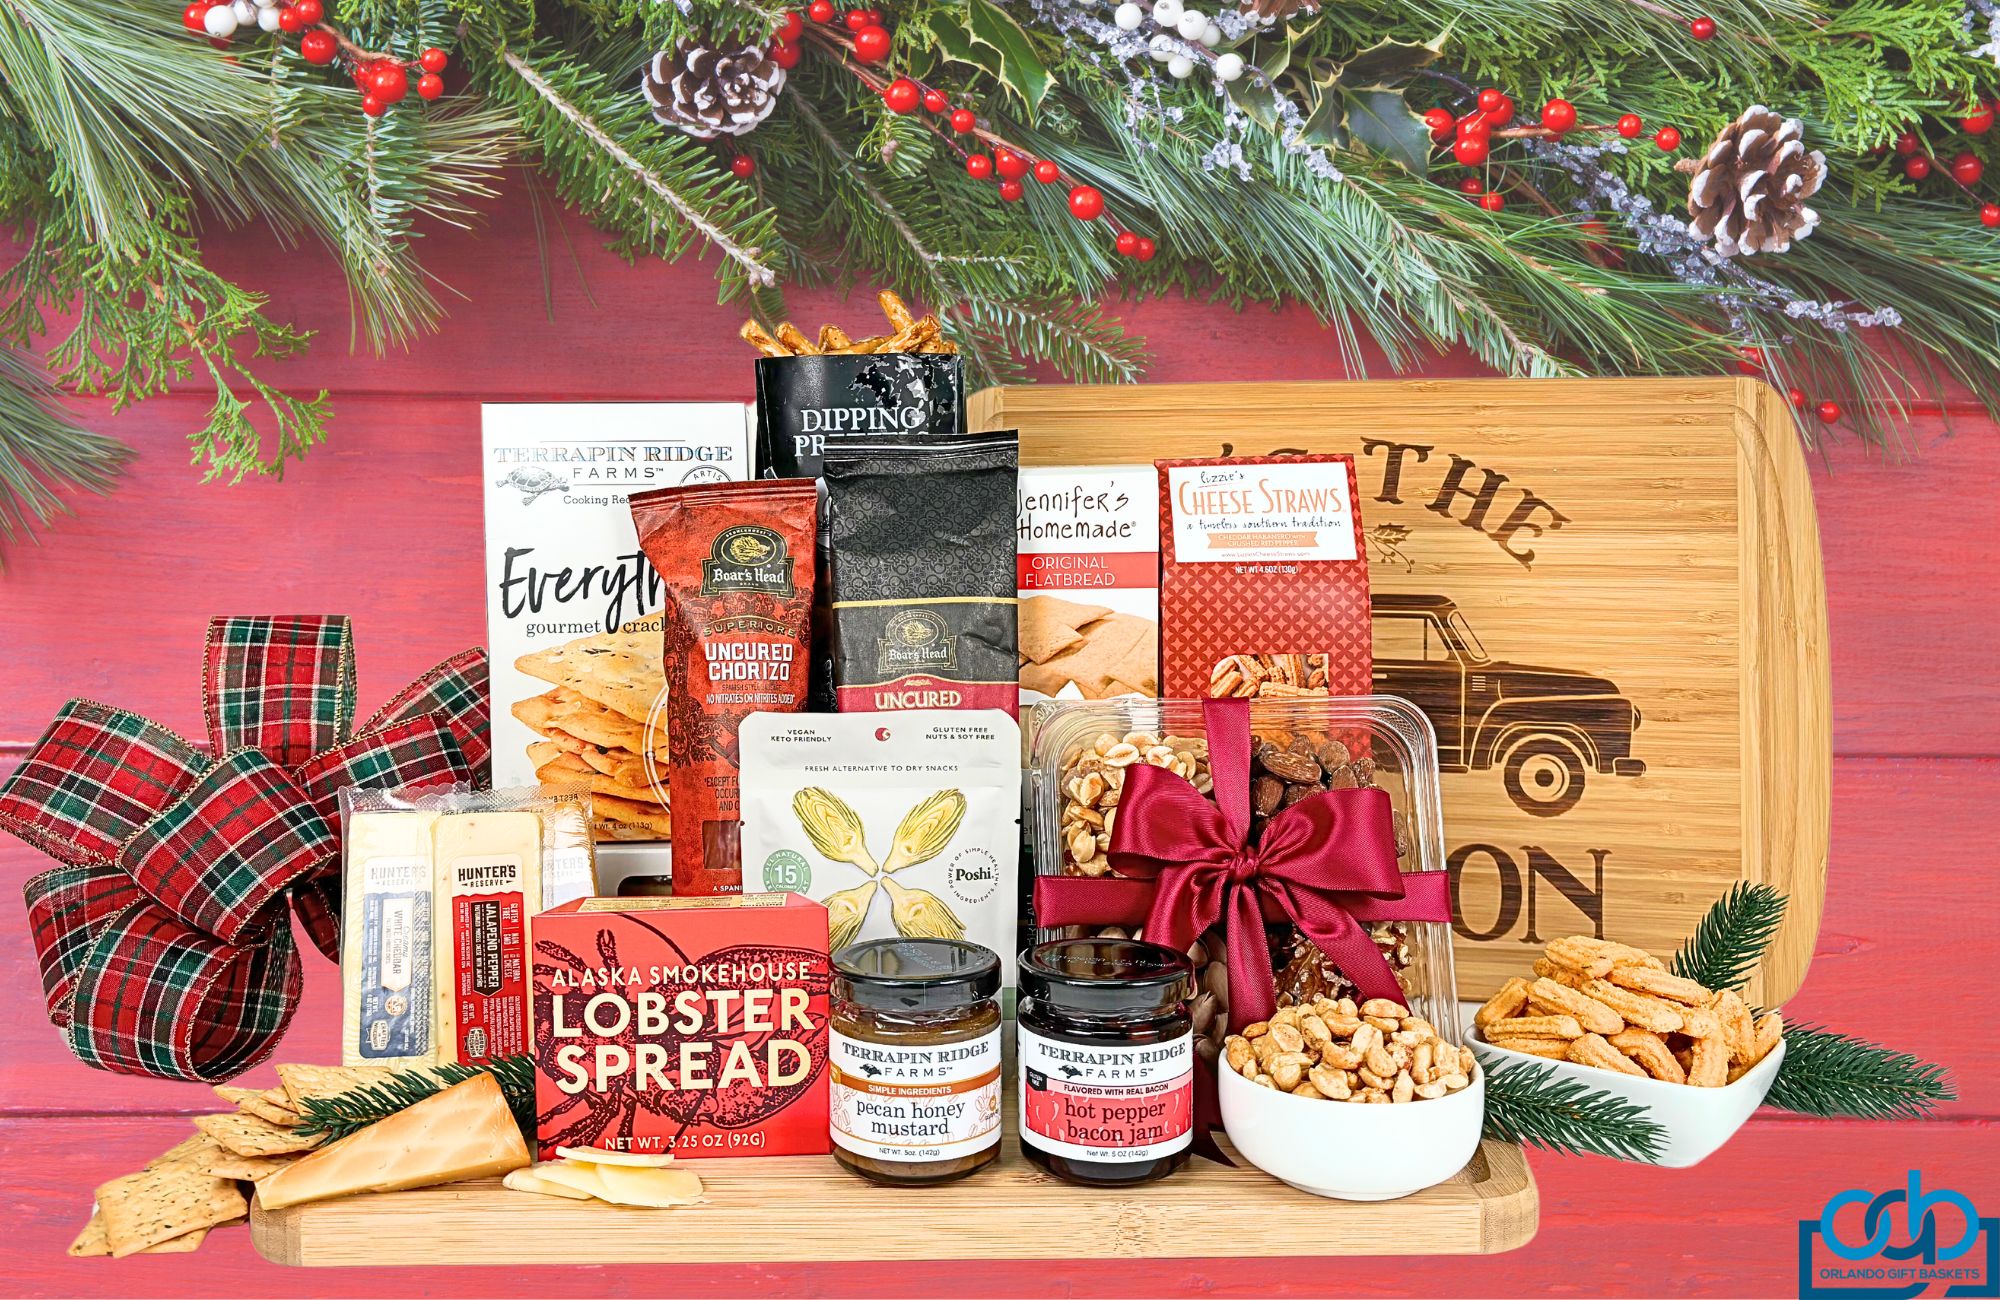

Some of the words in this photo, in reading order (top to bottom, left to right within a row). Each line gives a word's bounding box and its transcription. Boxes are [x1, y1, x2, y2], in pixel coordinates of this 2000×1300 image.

[801, 406, 927, 432] DIPPING
[494, 446, 637, 463] TERRAPIN
[643, 445, 733, 462] RIDGE
[793, 434, 825, 457] PR
[693, 470, 722, 481] ARTIS
[563, 495, 608, 506] Cooking
[1016, 480, 1129, 518] Jennifer's
[1178, 480, 1255, 516] CHEESE
[1360, 436, 1572, 572] THE
[1186, 522, 1194, 530] a
[1199, 518, 1238, 530] timeless
[1242, 517, 1288, 529] southern
[1292, 516, 1342, 529] tradition
[1032, 556, 1109, 569] ORIGINAL
[1236, 566, 1246, 574] NET
[1248, 566, 1259, 574] WT
[712, 567, 753, 583] Boar's
[754, 567, 785, 584] Head
[1026, 574, 1115, 588] FLATBREAD
[500, 547, 665, 635] Everyth
[526, 618, 601, 637] gourmet
[703, 620, 797, 638] SUPERIORE
[705, 642, 793, 662] UNCURED
[888, 648, 919, 661] Boar's
[921, 646, 948, 659] Head
[709, 662, 790, 681] CHORIZO
[706, 694, 715, 704] NO
[744, 694, 753, 703] OR
[874, 690, 962, 710] UNCURED
[715, 788, 741, 799] OCCUR
[719, 802, 733, 812] AND
[964, 848, 989, 856] SIMPLE
[458, 864, 517, 882] HUNTER'S
[764, 858, 775, 872] ALL
[774, 864, 797, 885] 15
[956, 866, 991, 881] Poshi
[470, 880, 504, 888] RESERVE
[1446, 843, 1613, 944] ON
[394, 910, 403, 936] WHITE
[502, 908, 511, 920] FREE
[510, 903, 520, 924] GLUTEN
[488, 954, 499, 988] PEPPER
[504, 960, 513, 979] CHEESE
[512, 958, 521, 983] NATURAL
[552, 966, 643, 988] ALASKA
[552, 988, 817, 1038] LOBSTER
[842, 1042, 933, 1064] TERRAPIN
[938, 1041, 989, 1063] RIDGE
[1038, 1042, 1135, 1066] TERRAPIN
[1139, 1042, 1186, 1064] RIDGE
[554, 1039, 812, 1095] SPREAD
[868, 1084, 897, 1095] SIMPLE
[898, 1086, 952, 1096] INGREDIENTS
[1064, 1084, 1103, 1095] FLAVORED
[1104, 1088, 1124, 1096] WITH
[1145, 1084, 1169, 1094] BACON
[856, 1100, 906, 1119] pecan
[912, 1102, 966, 1119] honey
[1064, 1098, 1096, 1119] hot
[1102, 1102, 1167, 1124] pepper
[871, 1118, 950, 1137] mustard
[1067, 1120, 1125, 1142] bacon
[1129, 1123, 1164, 1145] jam
[605, 1136, 634, 1150] NET
[638, 1136, 665, 1149] WT.
[668, 1135, 698, 1149] 3.25
[702, 1134, 724, 1147] OZ
[728, 1131, 766, 1149] (92G)
[918, 1148, 940, 1157] (142g)
[1128, 1150, 1149, 1158] (142g)
